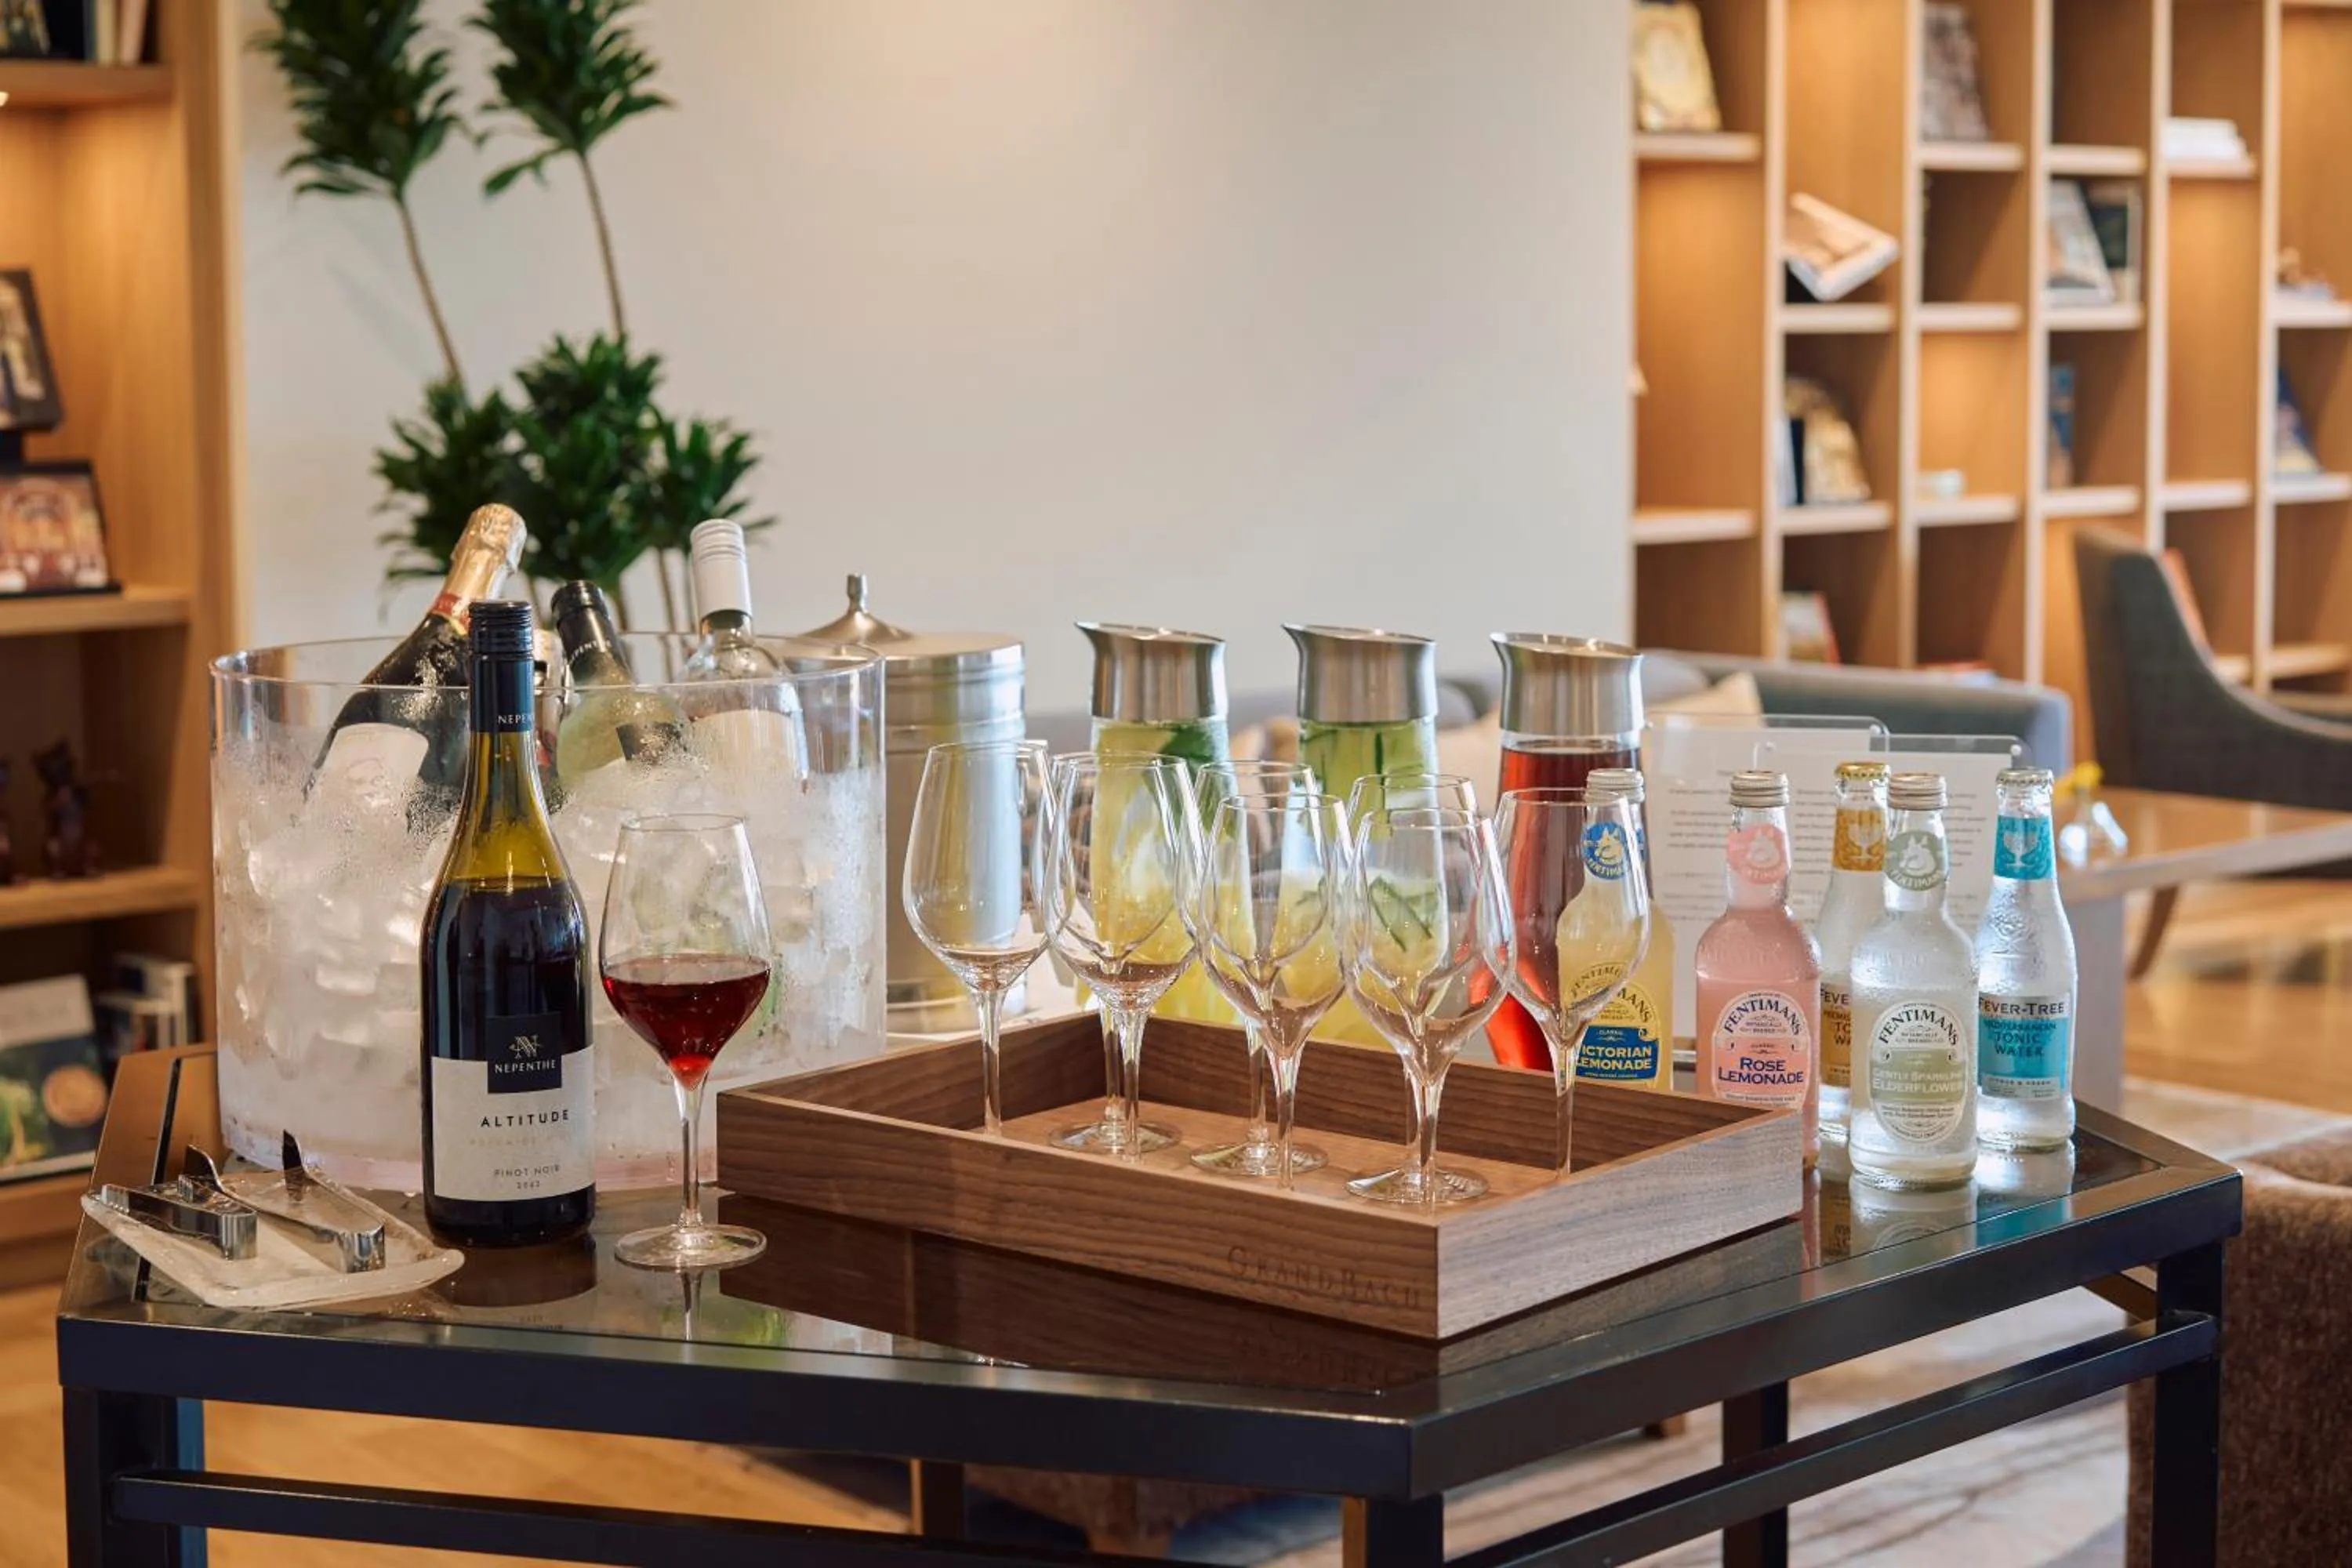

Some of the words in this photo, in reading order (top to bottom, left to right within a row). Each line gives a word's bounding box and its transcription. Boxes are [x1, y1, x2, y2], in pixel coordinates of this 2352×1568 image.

[1724, 998, 1802, 1036] FENTIMANS
[1878, 1009, 1958, 1045] FENTIMANS
[1993, 1031, 2042, 1044] TONIC
[1581, 1045, 1653, 1058] ICTORIAN
[1994, 1044, 2045, 1057] WATER
[494, 1059, 556, 1073] NEPENTHE
[1740, 1057, 1786, 1073] ROSE
[1718, 1066, 1804, 1084] LEMONADE
[480, 1109, 569, 1127] ALTITUDE
